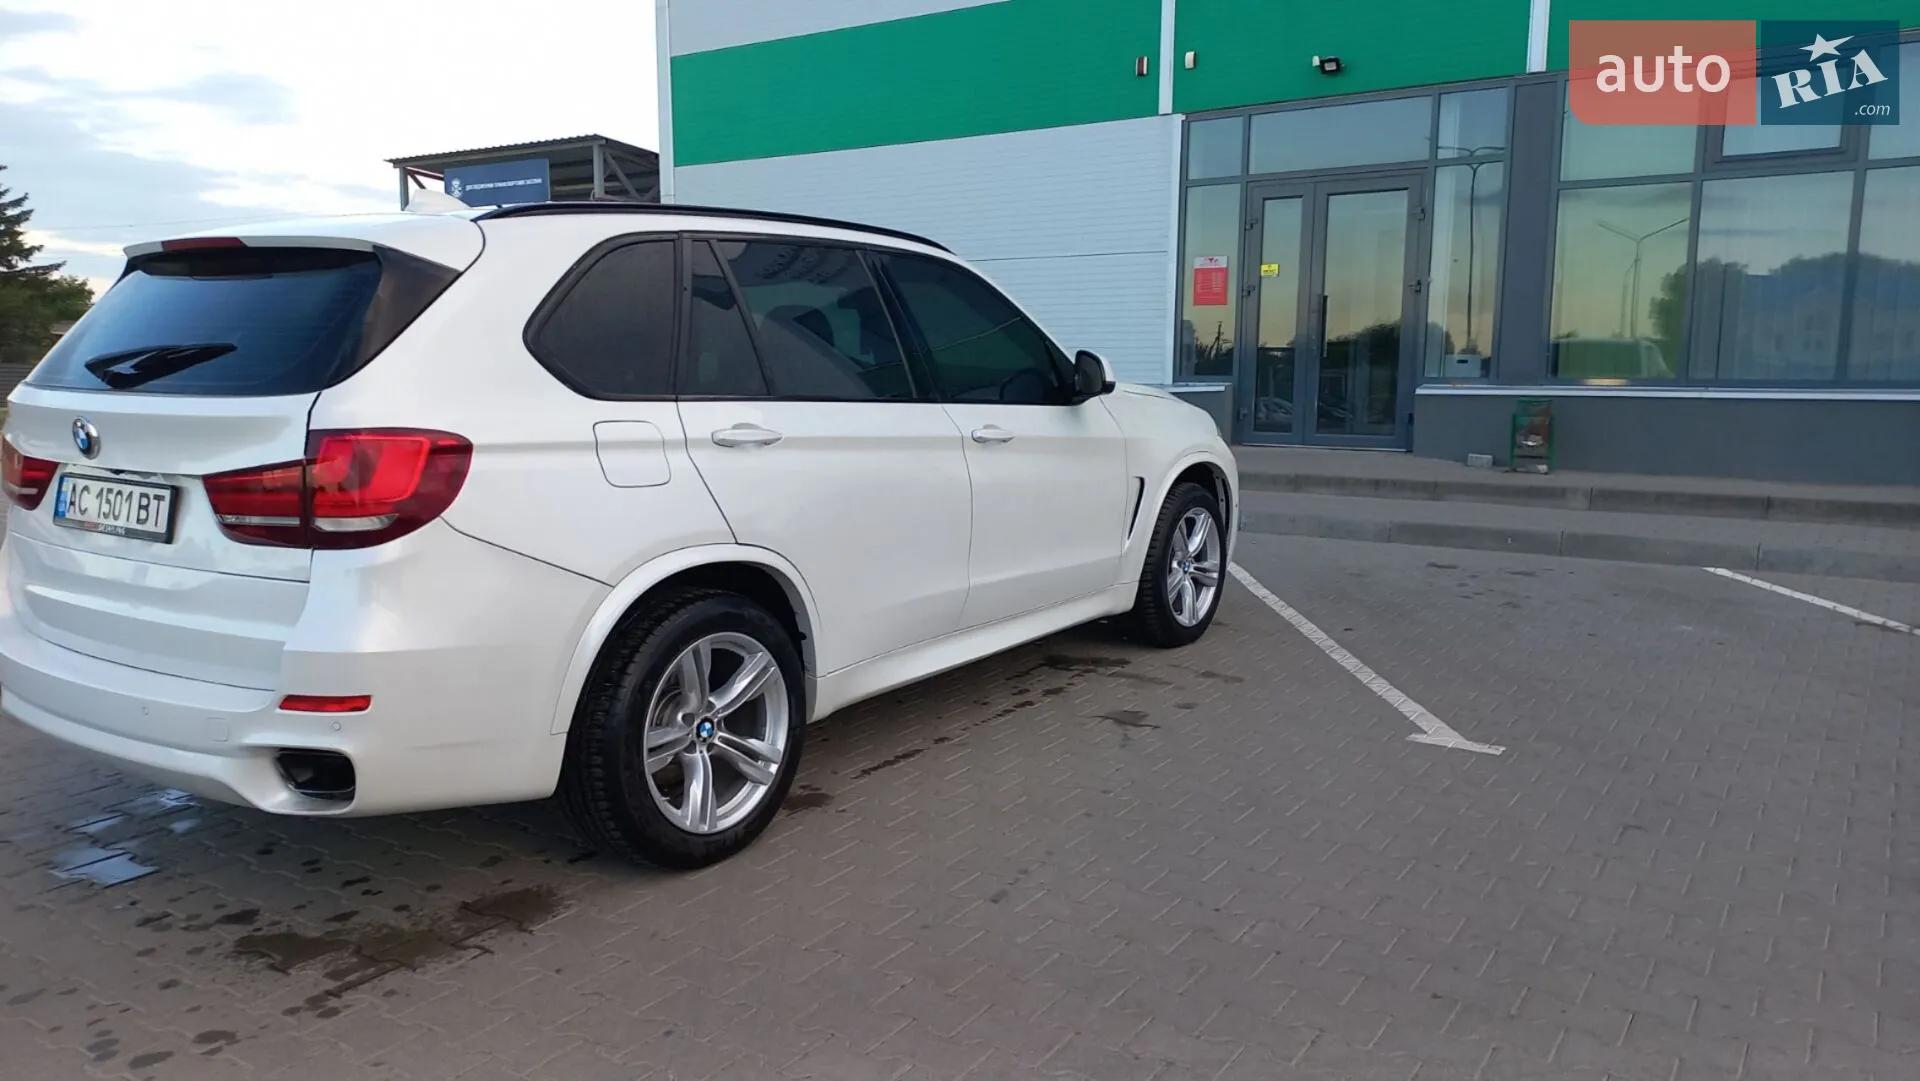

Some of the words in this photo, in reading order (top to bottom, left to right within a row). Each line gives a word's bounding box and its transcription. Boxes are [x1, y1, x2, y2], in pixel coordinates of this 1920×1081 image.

[67, 483, 91, 516] AC
[96, 486, 133, 523] 1501
[136, 492, 166, 528] BT
